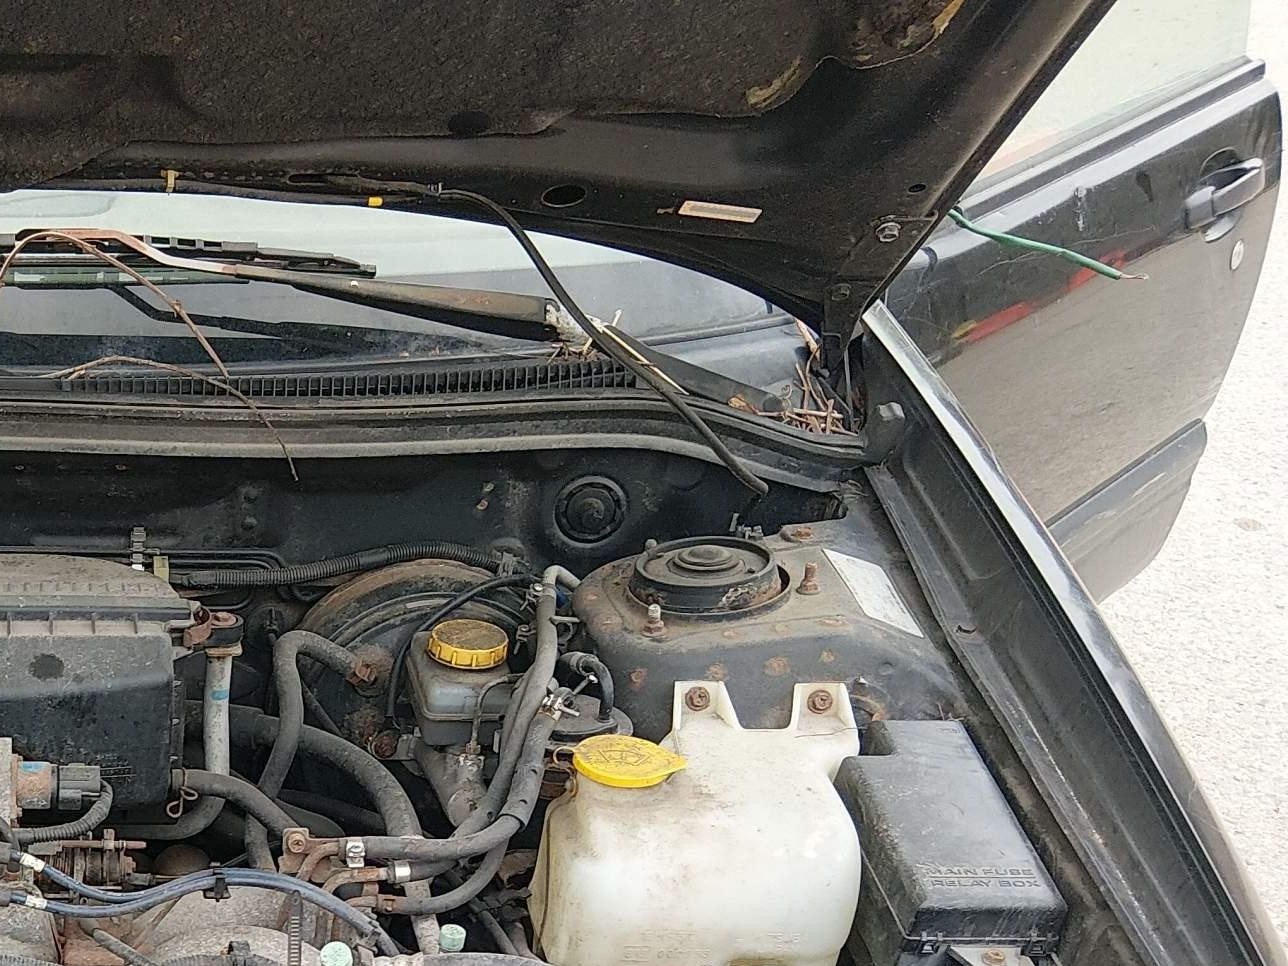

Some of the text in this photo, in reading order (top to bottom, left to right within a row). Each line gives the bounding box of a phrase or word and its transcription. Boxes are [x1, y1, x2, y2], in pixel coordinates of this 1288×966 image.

[927, 867, 1035, 876] MAIN FUSE
[930, 879, 992, 887] RELAY
